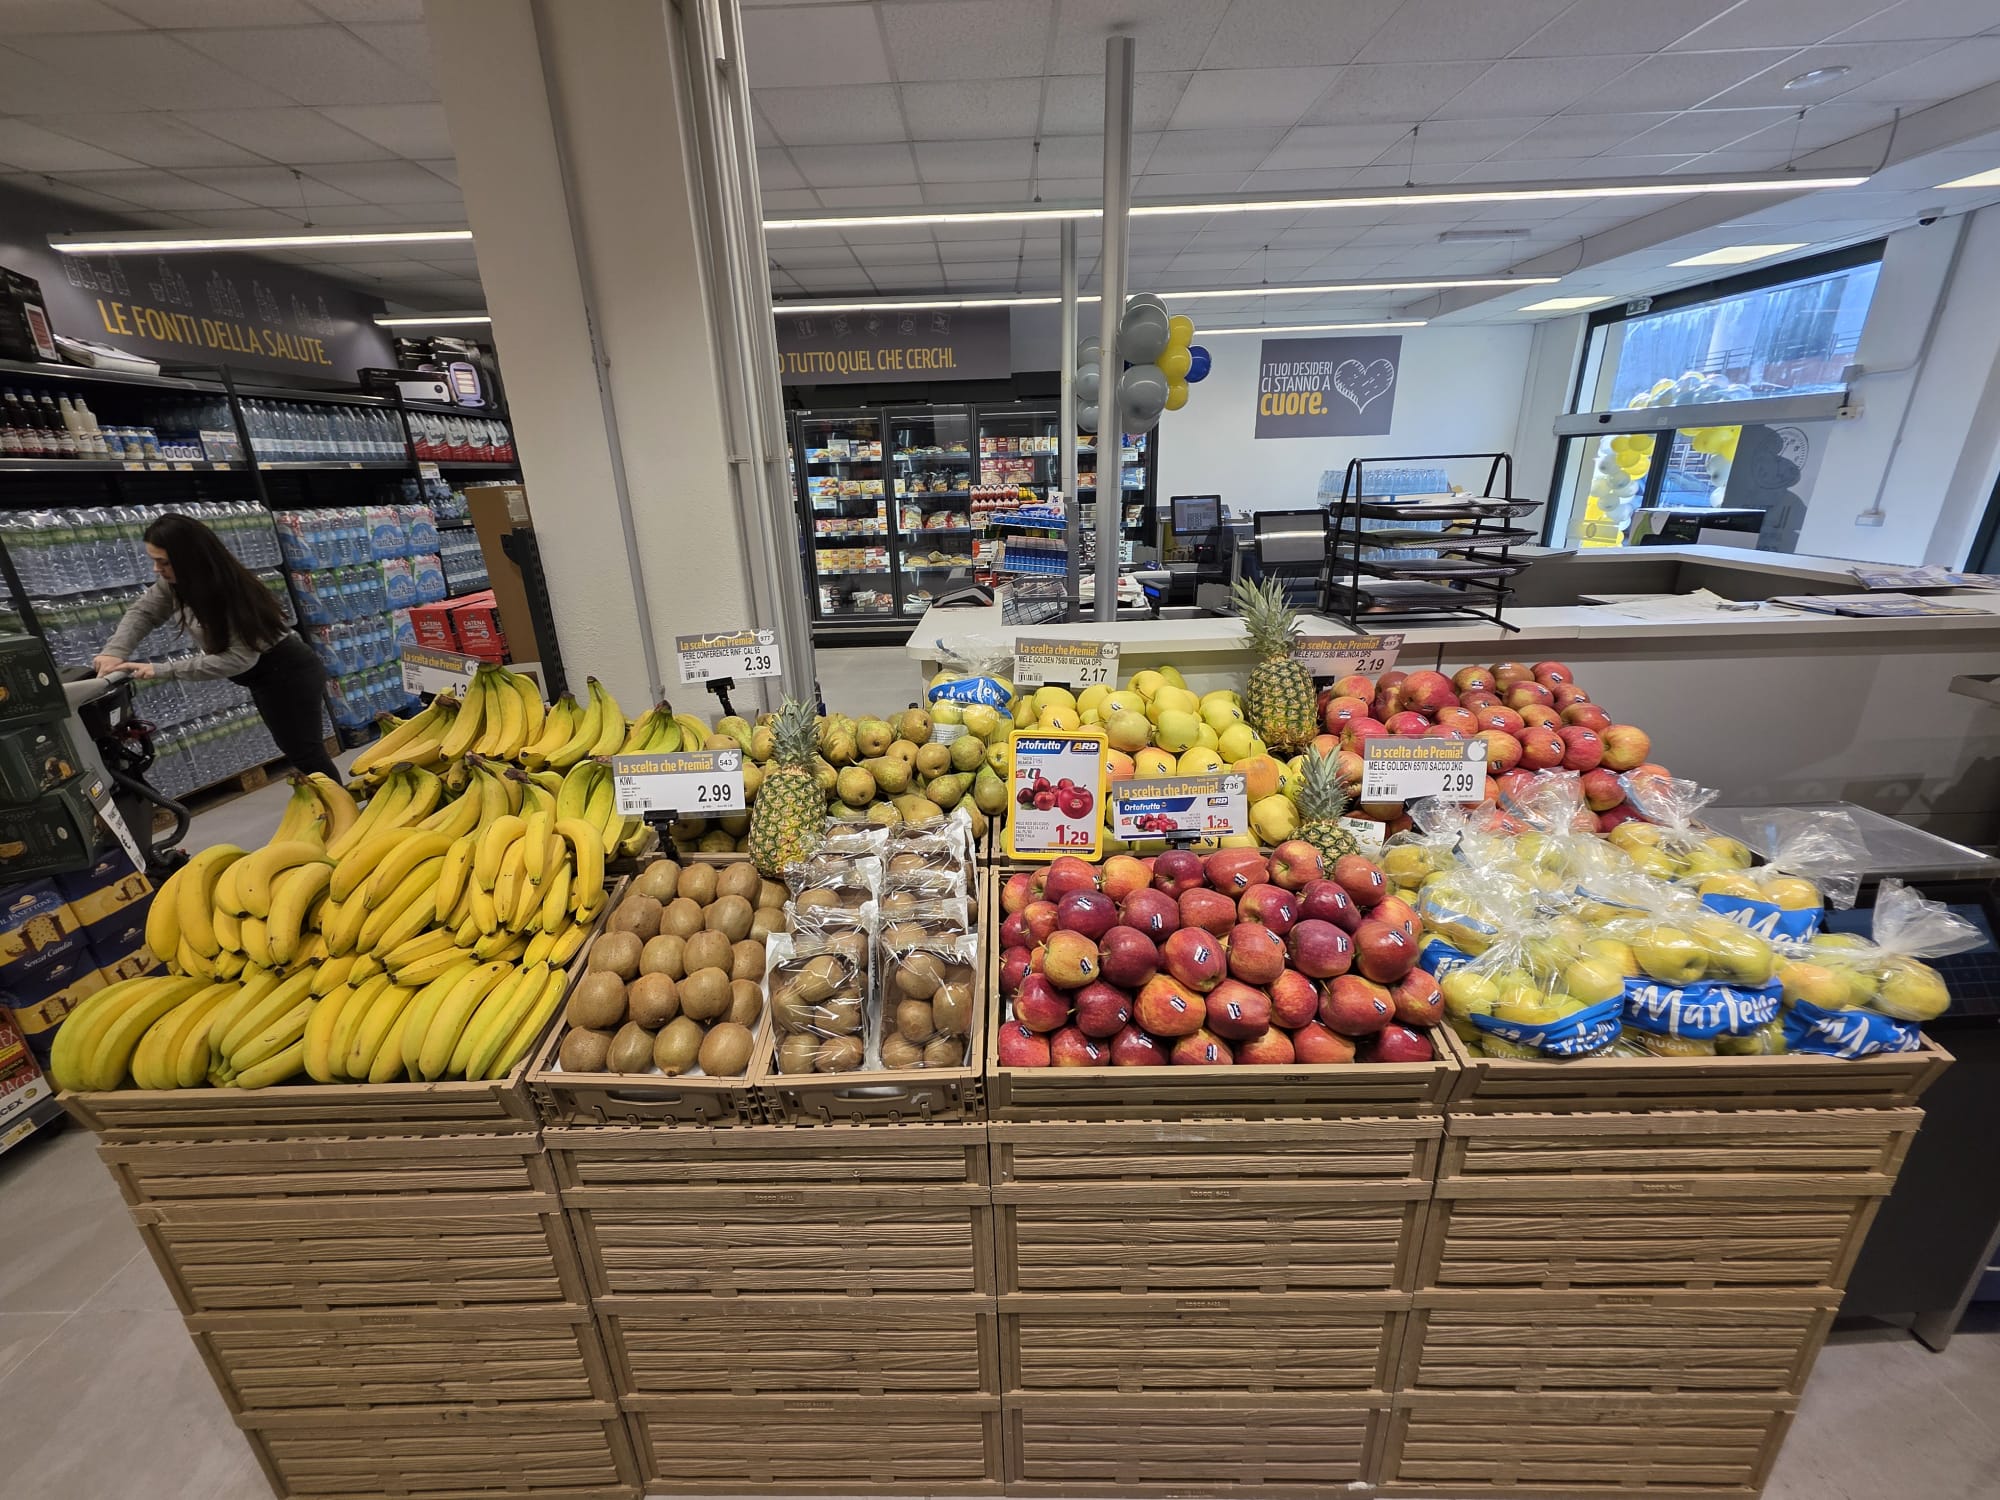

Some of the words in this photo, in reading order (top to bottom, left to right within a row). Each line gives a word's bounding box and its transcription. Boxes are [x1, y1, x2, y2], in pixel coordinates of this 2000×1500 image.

[97, 299, 133, 336] LE
[131, 306, 202, 346] FONTI
[201, 318, 264, 356] DELLA
[262, 329, 333, 366] SALUTE.
[787, 351, 833, 373] TUTTO
[837, 350, 874, 374] QUEL
[877, 349, 903, 371] CHE
[906, 347, 957, 369] CERCHI.
[1262, 364, 1266, 376] I
[1268, 362, 1291, 376] TUOI
[1293, 361, 1333, 376] DESIDERI
[1261, 377, 1271, 392] CI
[1273, 375, 1320, 392] STANNO
[1322, 375, 1331, 391] A
[1260, 392, 1328, 416] cuore.
[680, 641, 690, 651] La
[1020, 643, 1030, 654] La
[1030, 644, 1053, 655] scelta
[1055, 644, 1068, 655] che
[1069, 645, 1098, 657] Premia!
[1307, 640, 1332, 650] scelta
[1332, 640, 1347, 650] che
[1348, 639, 1379, 650] Premia!
[696, 649, 730, 659] CONFERENCE
[1019, 655, 1032, 663] MELE
[1033, 656, 1054, 664] GOLDEN
[744, 655, 771, 671] 2.39
[1354, 658, 1385, 672] 2.19
[1080, 667, 1108, 683] 2.17
[452, 682, 468, 698] 1.3
[1016, 740, 1061, 750] Ortofrutta
[1072, 742, 1098, 750] ARD
[1371, 745, 1382, 758] La
[1383, 745, 1412, 759] scelta
[1413, 745, 1429, 759] che
[1430, 745, 1464, 759] Premia!
[618, 762, 630, 775] La
[631, 760, 659, 773] scelta
[660, 759, 677, 773] che
[678, 758, 714, 771] Premia!
[1368, 761, 1385, 771] MELE
[1386, 761, 1413, 771] GOLDEN
[1429, 761, 1450, 771] SACCO
[1451, 761, 1464, 771] 2KG
[1119, 786, 1130, 799] La
[1131, 784, 1161, 798] scelta
[1163, 784, 1180, 797] che
[1181, 781, 1218, 796] Premia!
[1220, 783, 1239, 791] 2736
[1442, 773, 1474, 792] 2.99
[697, 784, 732, 803] 2.99
[1124, 803, 1161, 812] Ortofrutta
[1207, 814, 1229, 829] 1,29
[1055, 824, 1089, 846] 1,29
